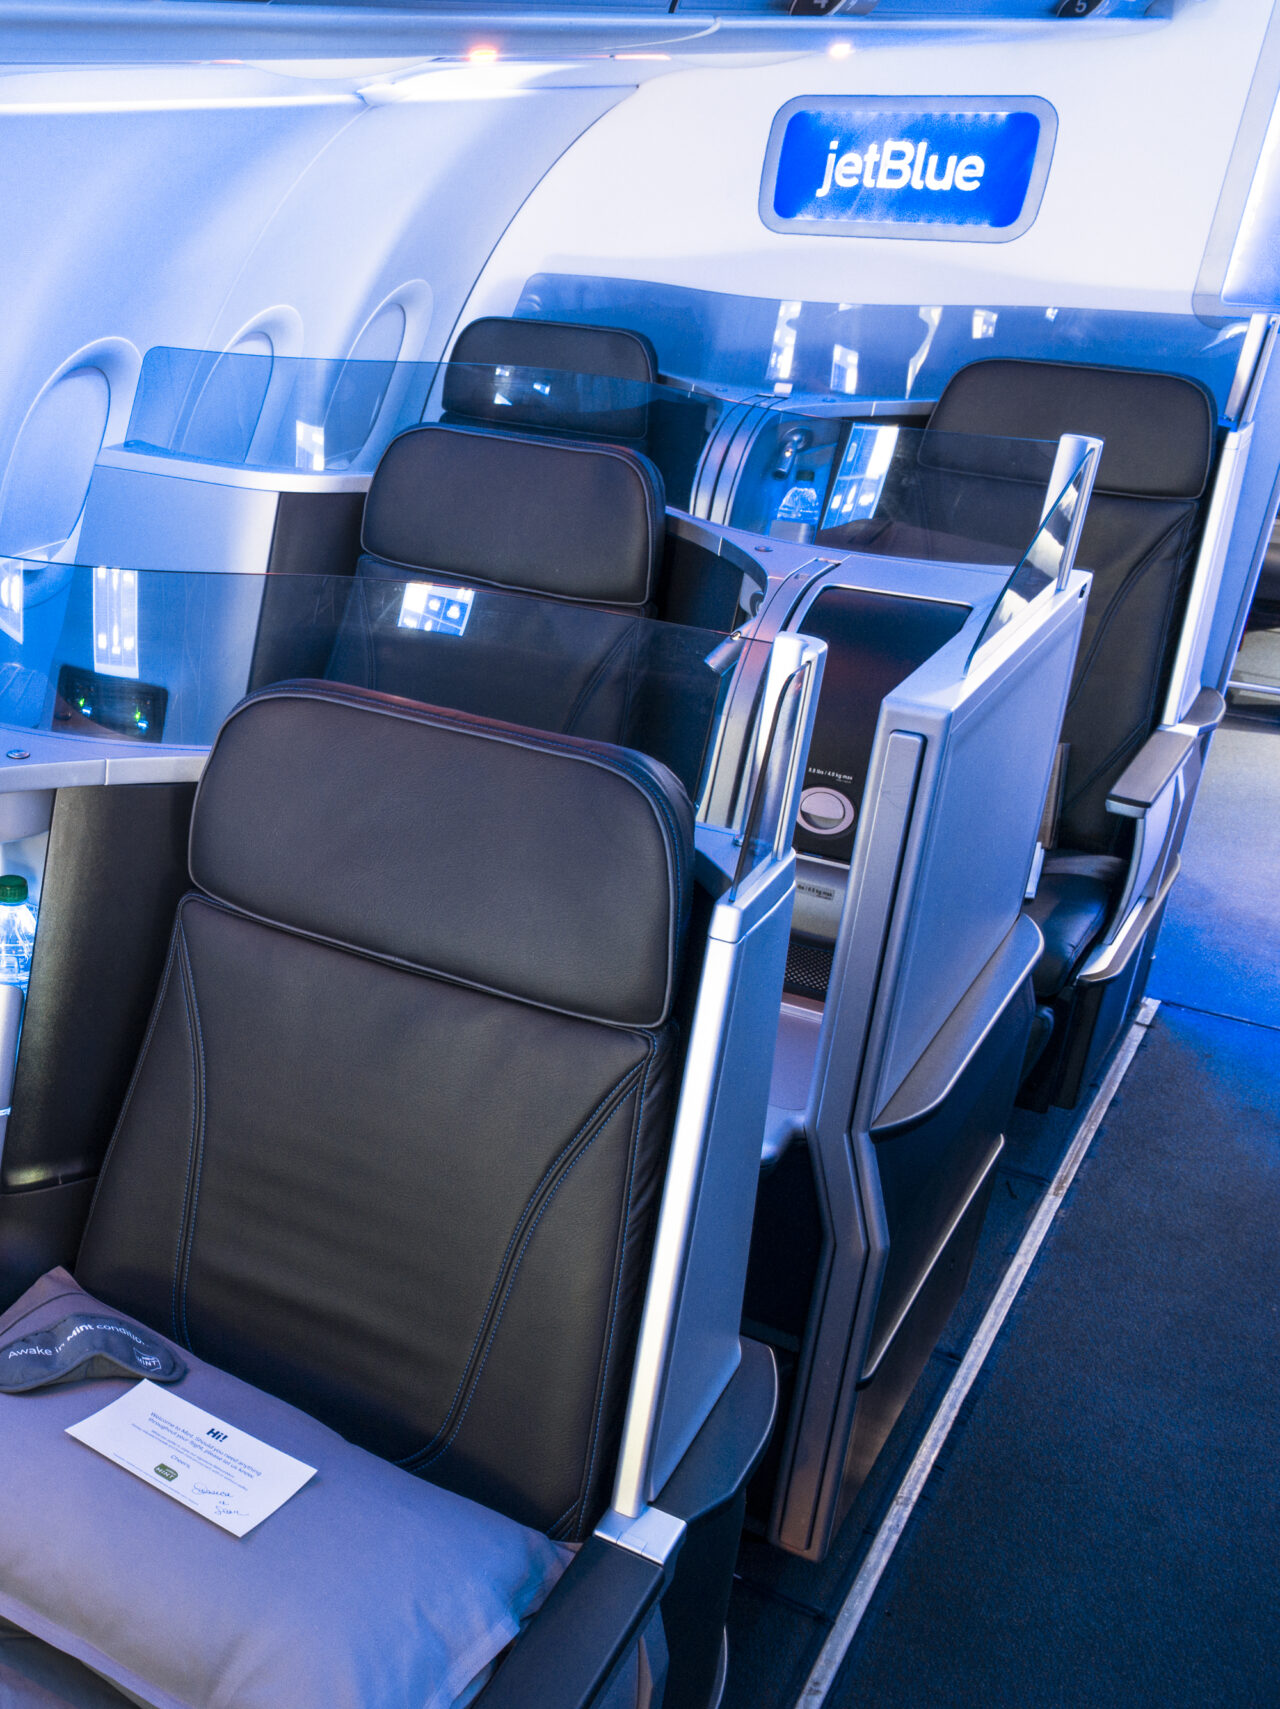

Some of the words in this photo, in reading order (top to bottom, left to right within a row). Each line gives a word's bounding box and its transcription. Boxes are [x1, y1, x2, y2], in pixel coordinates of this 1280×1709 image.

[815, 140, 985, 198] jetBlue
[8, 1345, 53, 1359] Awake
[67, 1323, 95, 1342] Mint
[96, 1324, 149, 1347] conditio
[206, 1428, 228, 1442] Hi!
